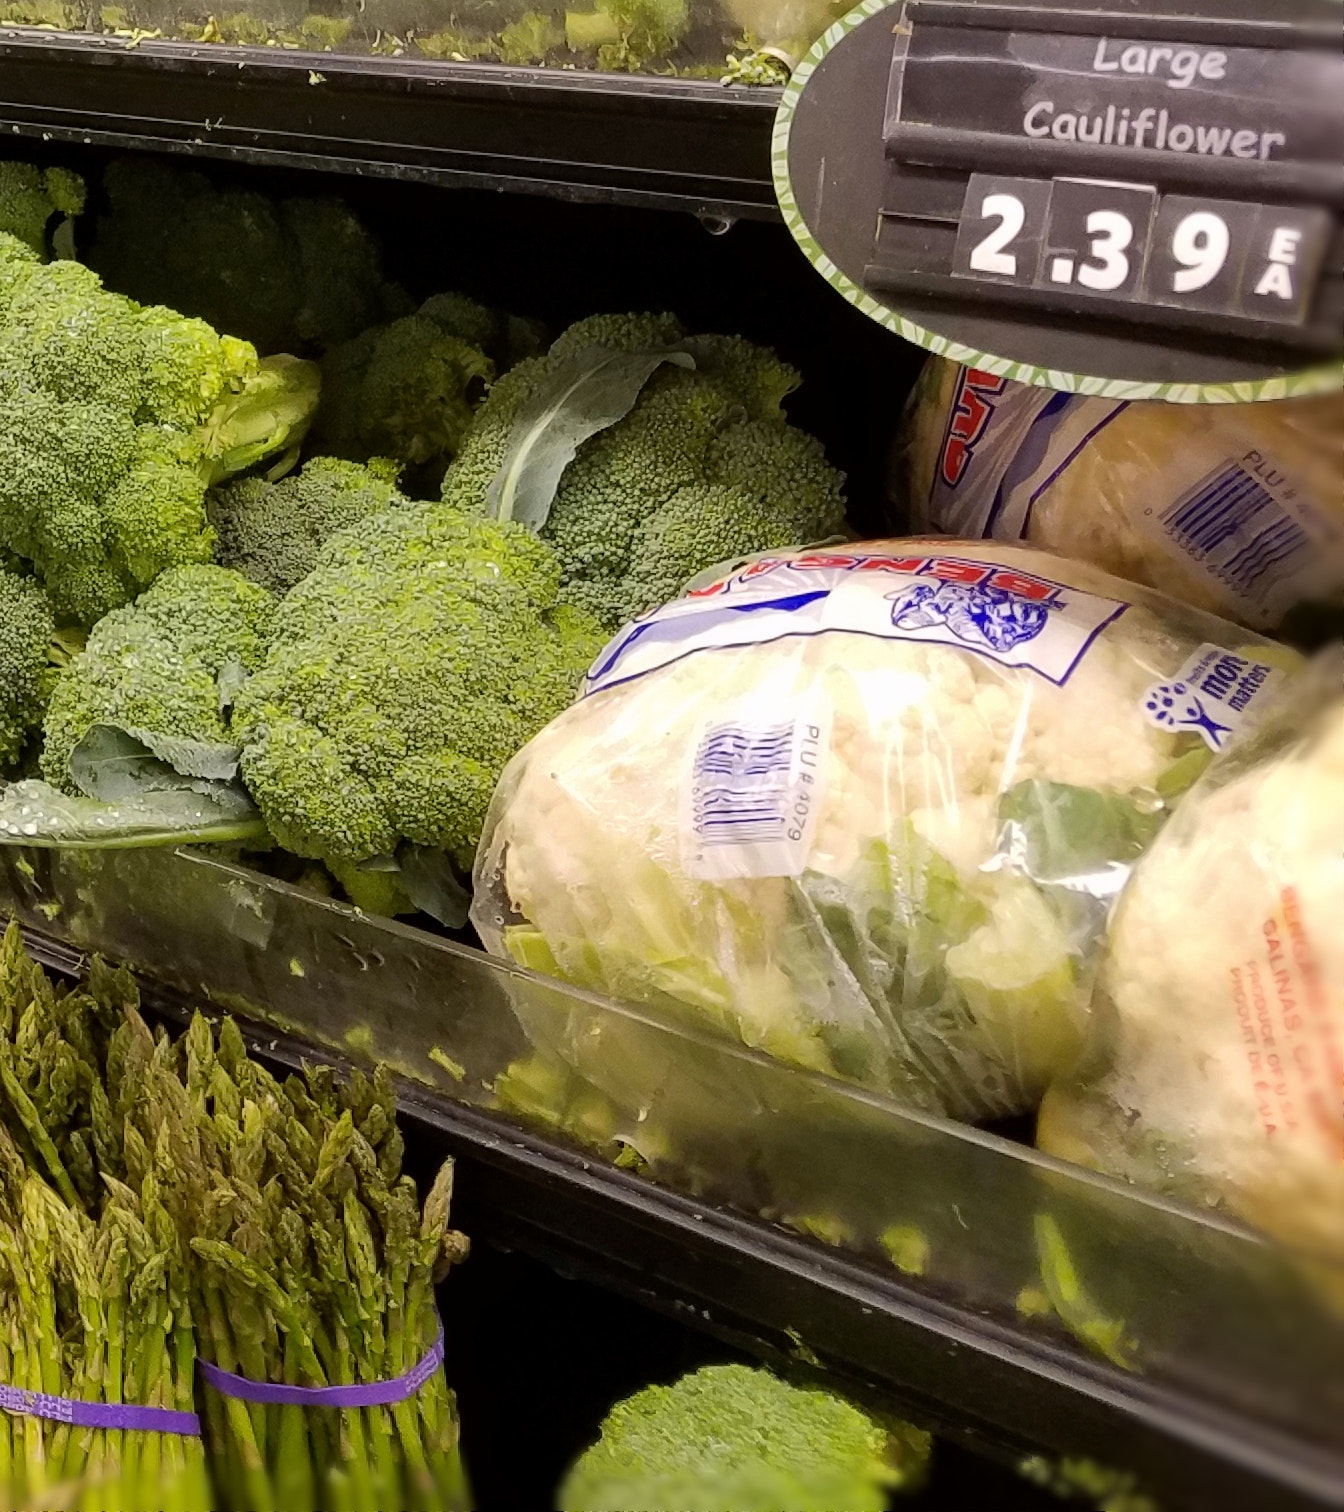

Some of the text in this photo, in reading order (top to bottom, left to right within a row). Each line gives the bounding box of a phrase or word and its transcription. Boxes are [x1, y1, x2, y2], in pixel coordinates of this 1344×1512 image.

[1093, 37, 1228, 89] Large
[1023, 100, 1286, 161] Cauliflower
[969, 193, 1231, 294] 2.39
[1242, 449, 1285, 489] PLU
[799, 724, 820, 768] PLU
